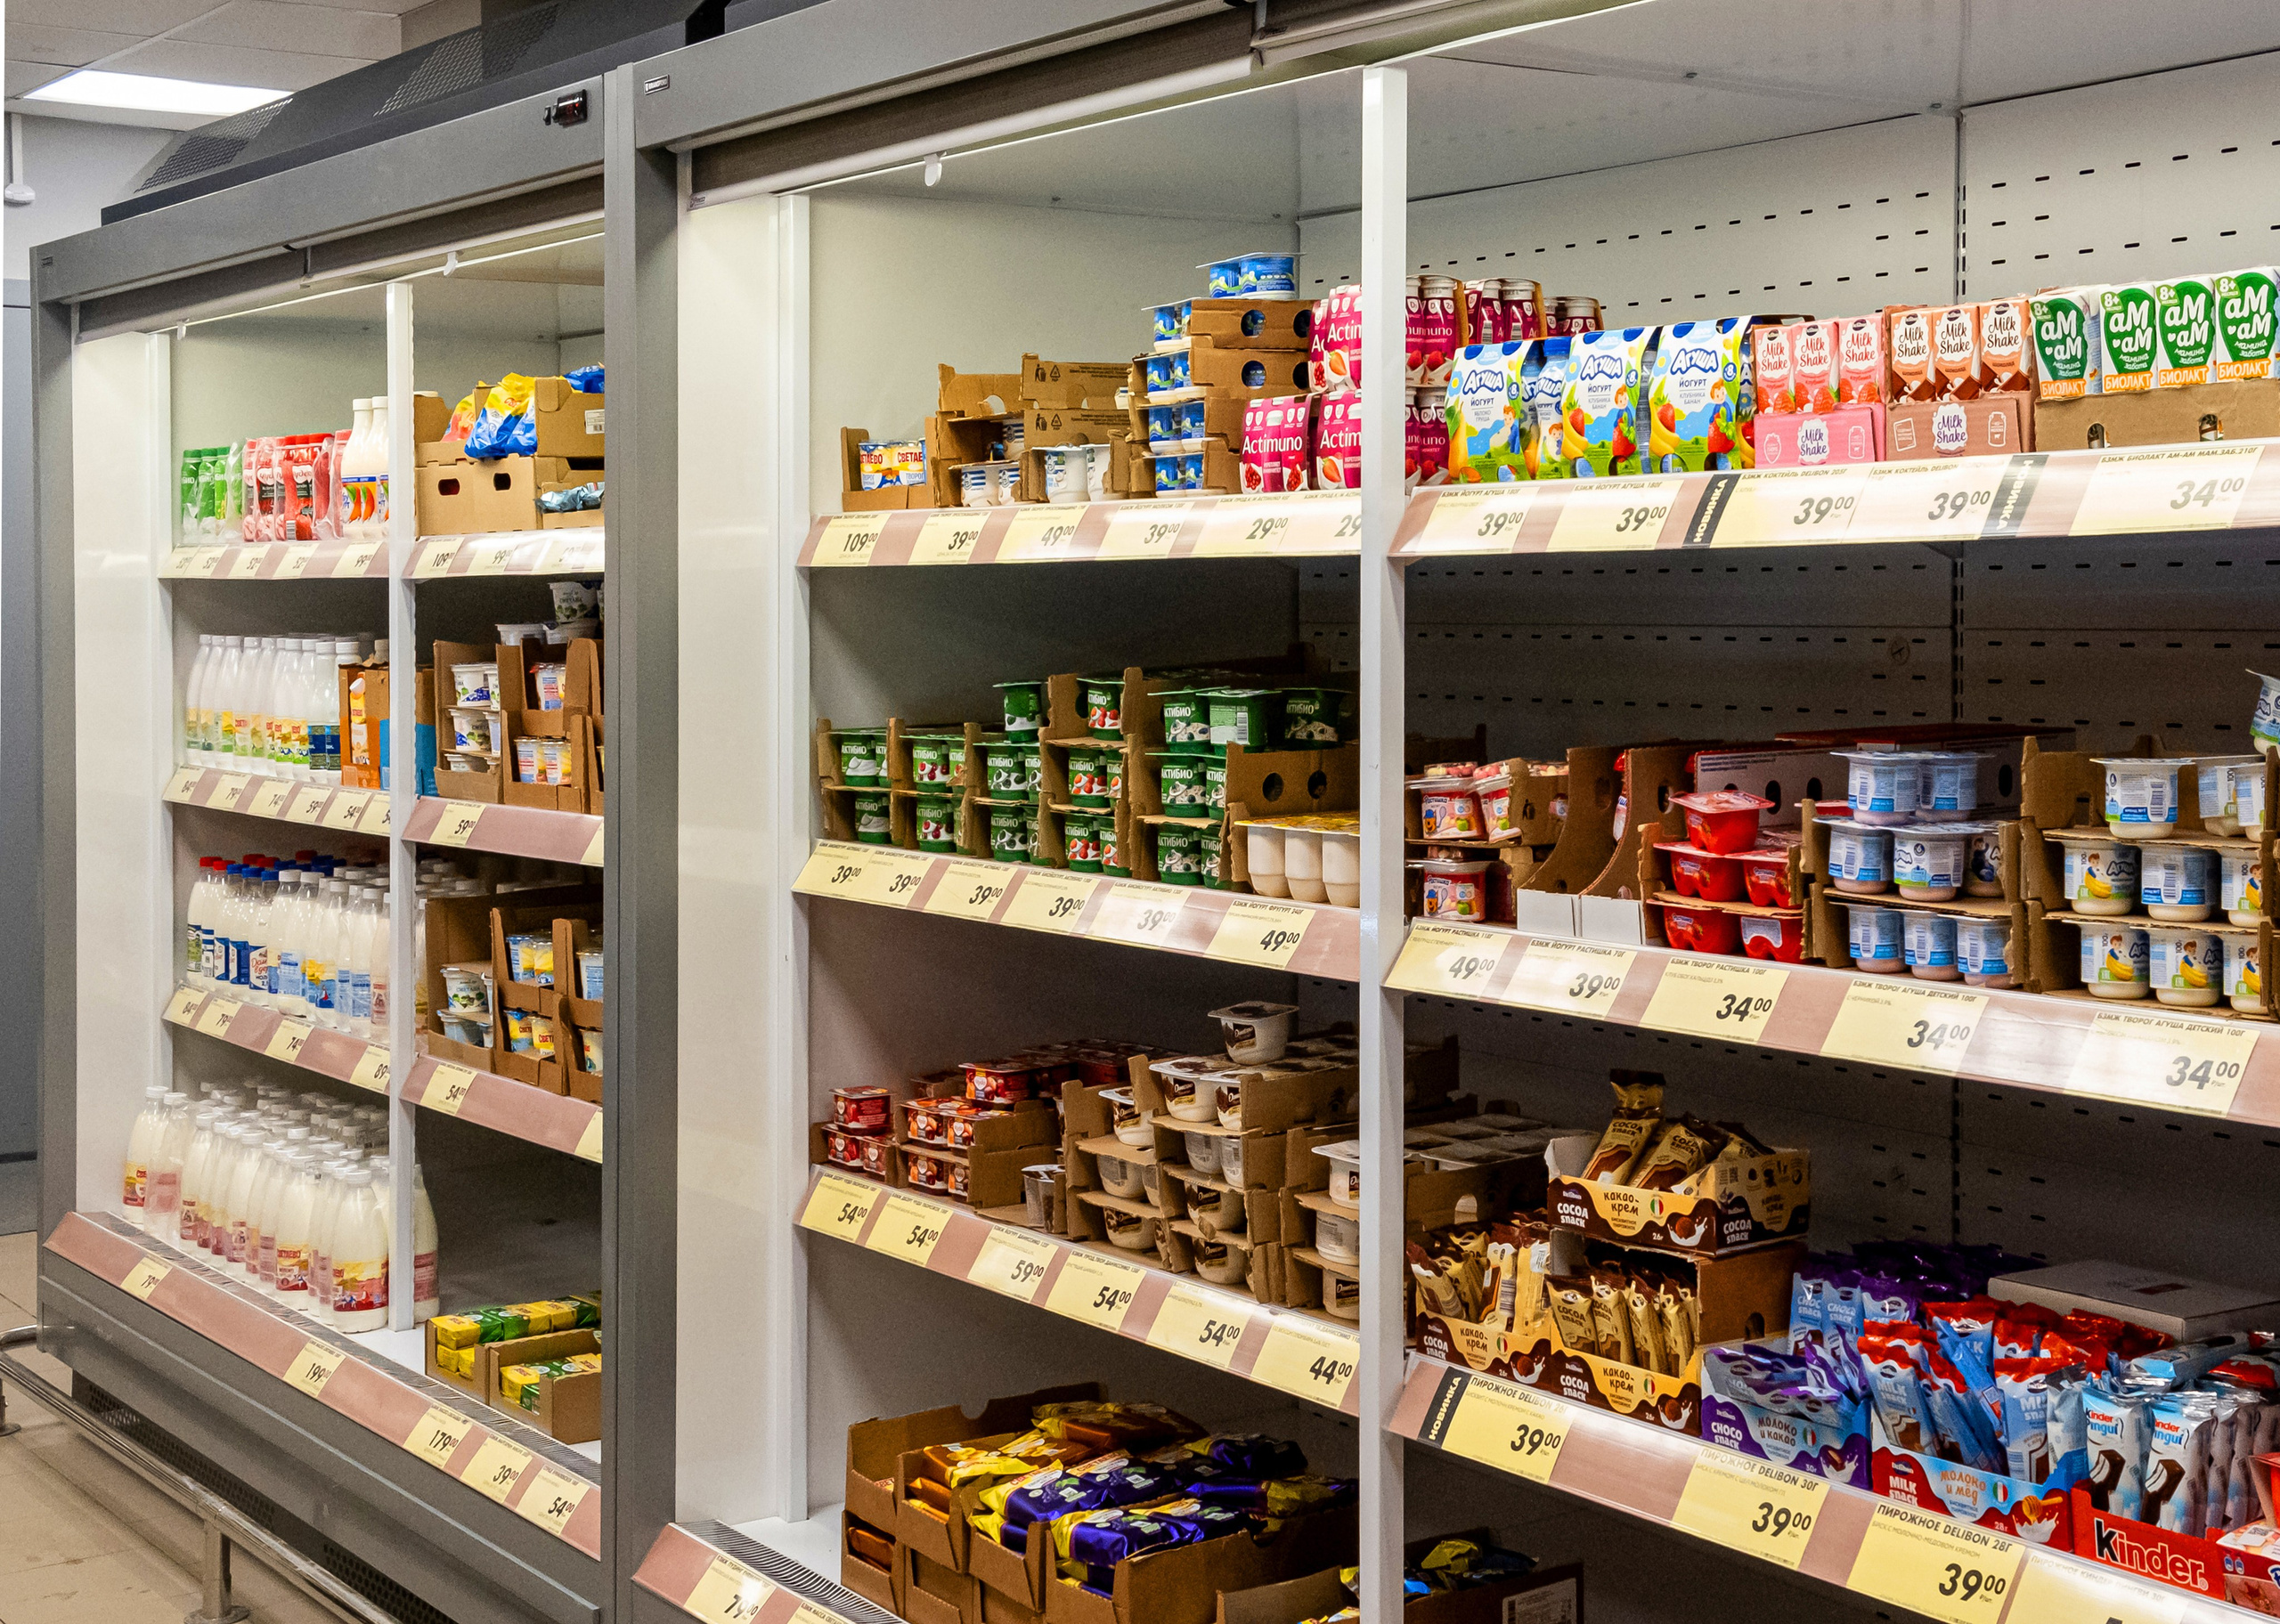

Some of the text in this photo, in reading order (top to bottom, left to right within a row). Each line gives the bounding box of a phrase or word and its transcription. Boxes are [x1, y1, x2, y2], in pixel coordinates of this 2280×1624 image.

[1941, 323, 1966, 339] Milk
[1989, 316, 2015, 333] Milk
[1846, 333, 1872, 349] Milk
[1899, 326, 1924, 343] Milk
[1987, 334, 2019, 348] Shake
[1763, 343, 1784, 358] Milk
[1802, 337, 1825, 353] Milk
[1898, 343, 1927, 358] Shake
[1940, 340, 1970, 354] Shake
[1671, 348, 1718, 375] АГУША
[1800, 353, 1828, 367] Shake
[1845, 350, 1875, 362] Shake
[1581, 354, 1622, 381] АГУША
[1762, 358, 1787, 371] Shake
[2219, 361, 2268, 378] БИОЛАКТ
[1462, 369, 1503, 395] АГУША
[1679, 378, 1706, 387] ЙОГУРТ
[2105, 374, 2151, 389] БИОЛАКТ
[2161, 368, 2207, 384] БИОЛАКТ
[1588, 385, 1611, 393] ЙОГУРТ
[2042, 381, 2085, 395] БИОЛАКТ
[1470, 398, 1494, 406] ЙОГУРТ
[1938, 415, 1962, 430] Milk
[1242, 434, 1302, 454] Actimuno
[1802, 429, 1823, 443] Milk
[1936, 429, 1966, 443] Shake
[1800, 443, 1828, 457] Shake
[2127, 453, 2165, 461] БИОЛАКТ
[1996, 459, 2033, 531] НОВИНКА
[1693, 478, 1729, 543] НОВИНКА
[1531, 939, 1551, 948] БЗМЖ
[1551, 942, 1575, 951] ЙОГУРТ
[1576, 945, 1612, 956] РАСТИШКА
[1671, 958, 1689, 966] БЗМЖ
[1690, 961, 1714, 969] ТВОРОГ
[1716, 963, 1750, 974] РАСТИШКА
[1853, 980, 1873, 989] БЗМЖ
[1875, 983, 1900, 992] ТВОРОГ
[1901, 987, 1926, 996] АГУША
[1927, 990, 1958, 1001] ДЕТСКИЙ
[2097, 1013, 2120, 1022] БЗМЖ
[2123, 1016, 2154, 1026] ТВОРОГ
[2155, 1020, 2184, 1029] АГУША
[2186, 1024, 2223, 1034] ДЕТСКИЙ
[1558, 1202, 1588, 1219] COCOA
[1611, 1202, 1639, 1216] крем
[1723, 1219, 1752, 1234] COCOA
[1558, 1304, 1585, 1322] COCOA
[1424, 1336, 1448, 1352] COCOA
[1467, 1339, 1487, 1352] крем
[1560, 1374, 1589, 1393] COCOA
[1609, 1378, 1633, 1393] крем
[1470, 1377, 1552, 1409] ПИРОЖНОЕ DELIBON
[1429, 1376, 1462, 1441] НОВИНКА
[2086, 1408, 2113, 1423] Kinder
[1712, 1422, 1742, 1441] CHOCO
[1758, 1417, 1797, 1436] МОЛОКО
[1768, 1431, 1796, 1446] какао
[1701, 1449, 1818, 1492] ПИРОЖНОЕ DELIBON 30Г
[1889, 1475, 1917, 1494] MILK
[1877, 1504, 2013, 1553] ПИРОЖНОЕ DELIBON 28Г
[2095, 1518, 2204, 1588] Kinder
